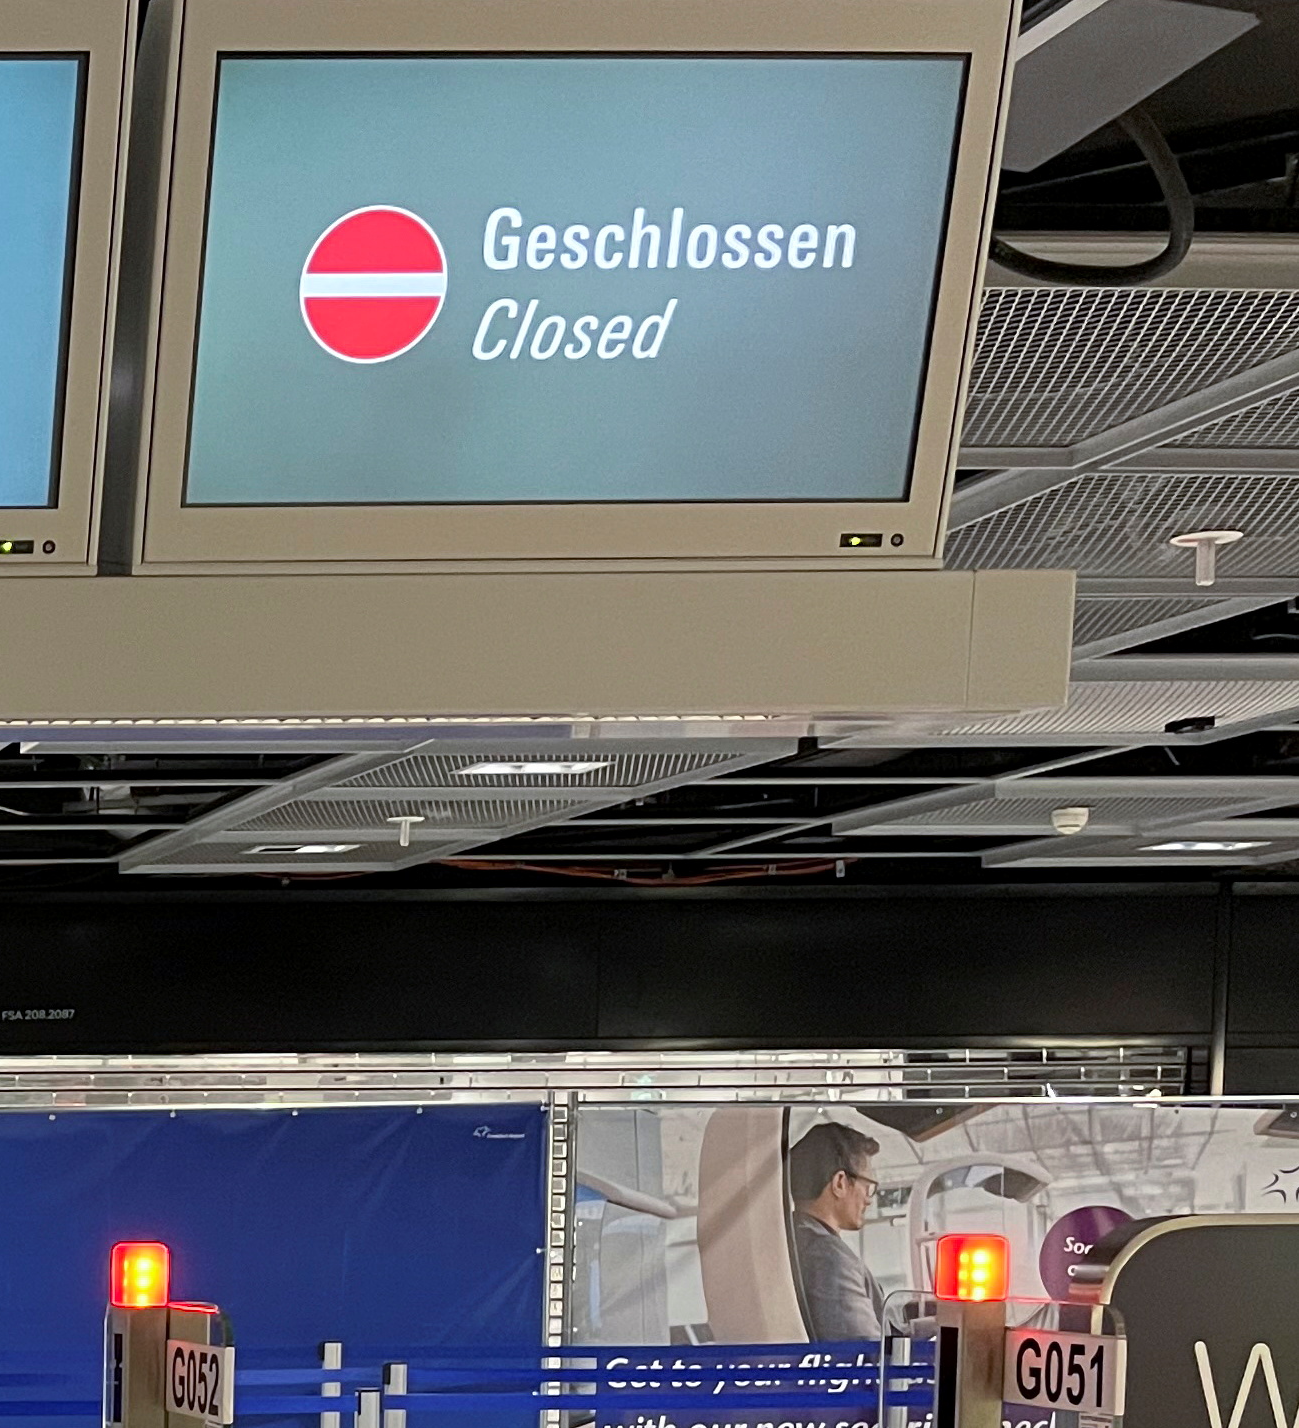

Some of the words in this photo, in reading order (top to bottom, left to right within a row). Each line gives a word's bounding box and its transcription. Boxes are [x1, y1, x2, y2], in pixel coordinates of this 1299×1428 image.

[482, 206, 855, 270] Geschlossen
[471, 297, 678, 360] Closed
[1, 1010, 23, 1020] FSA
[172, 1346, 219, 1417] G052
[1016, 1337, 1104, 1408] G051
